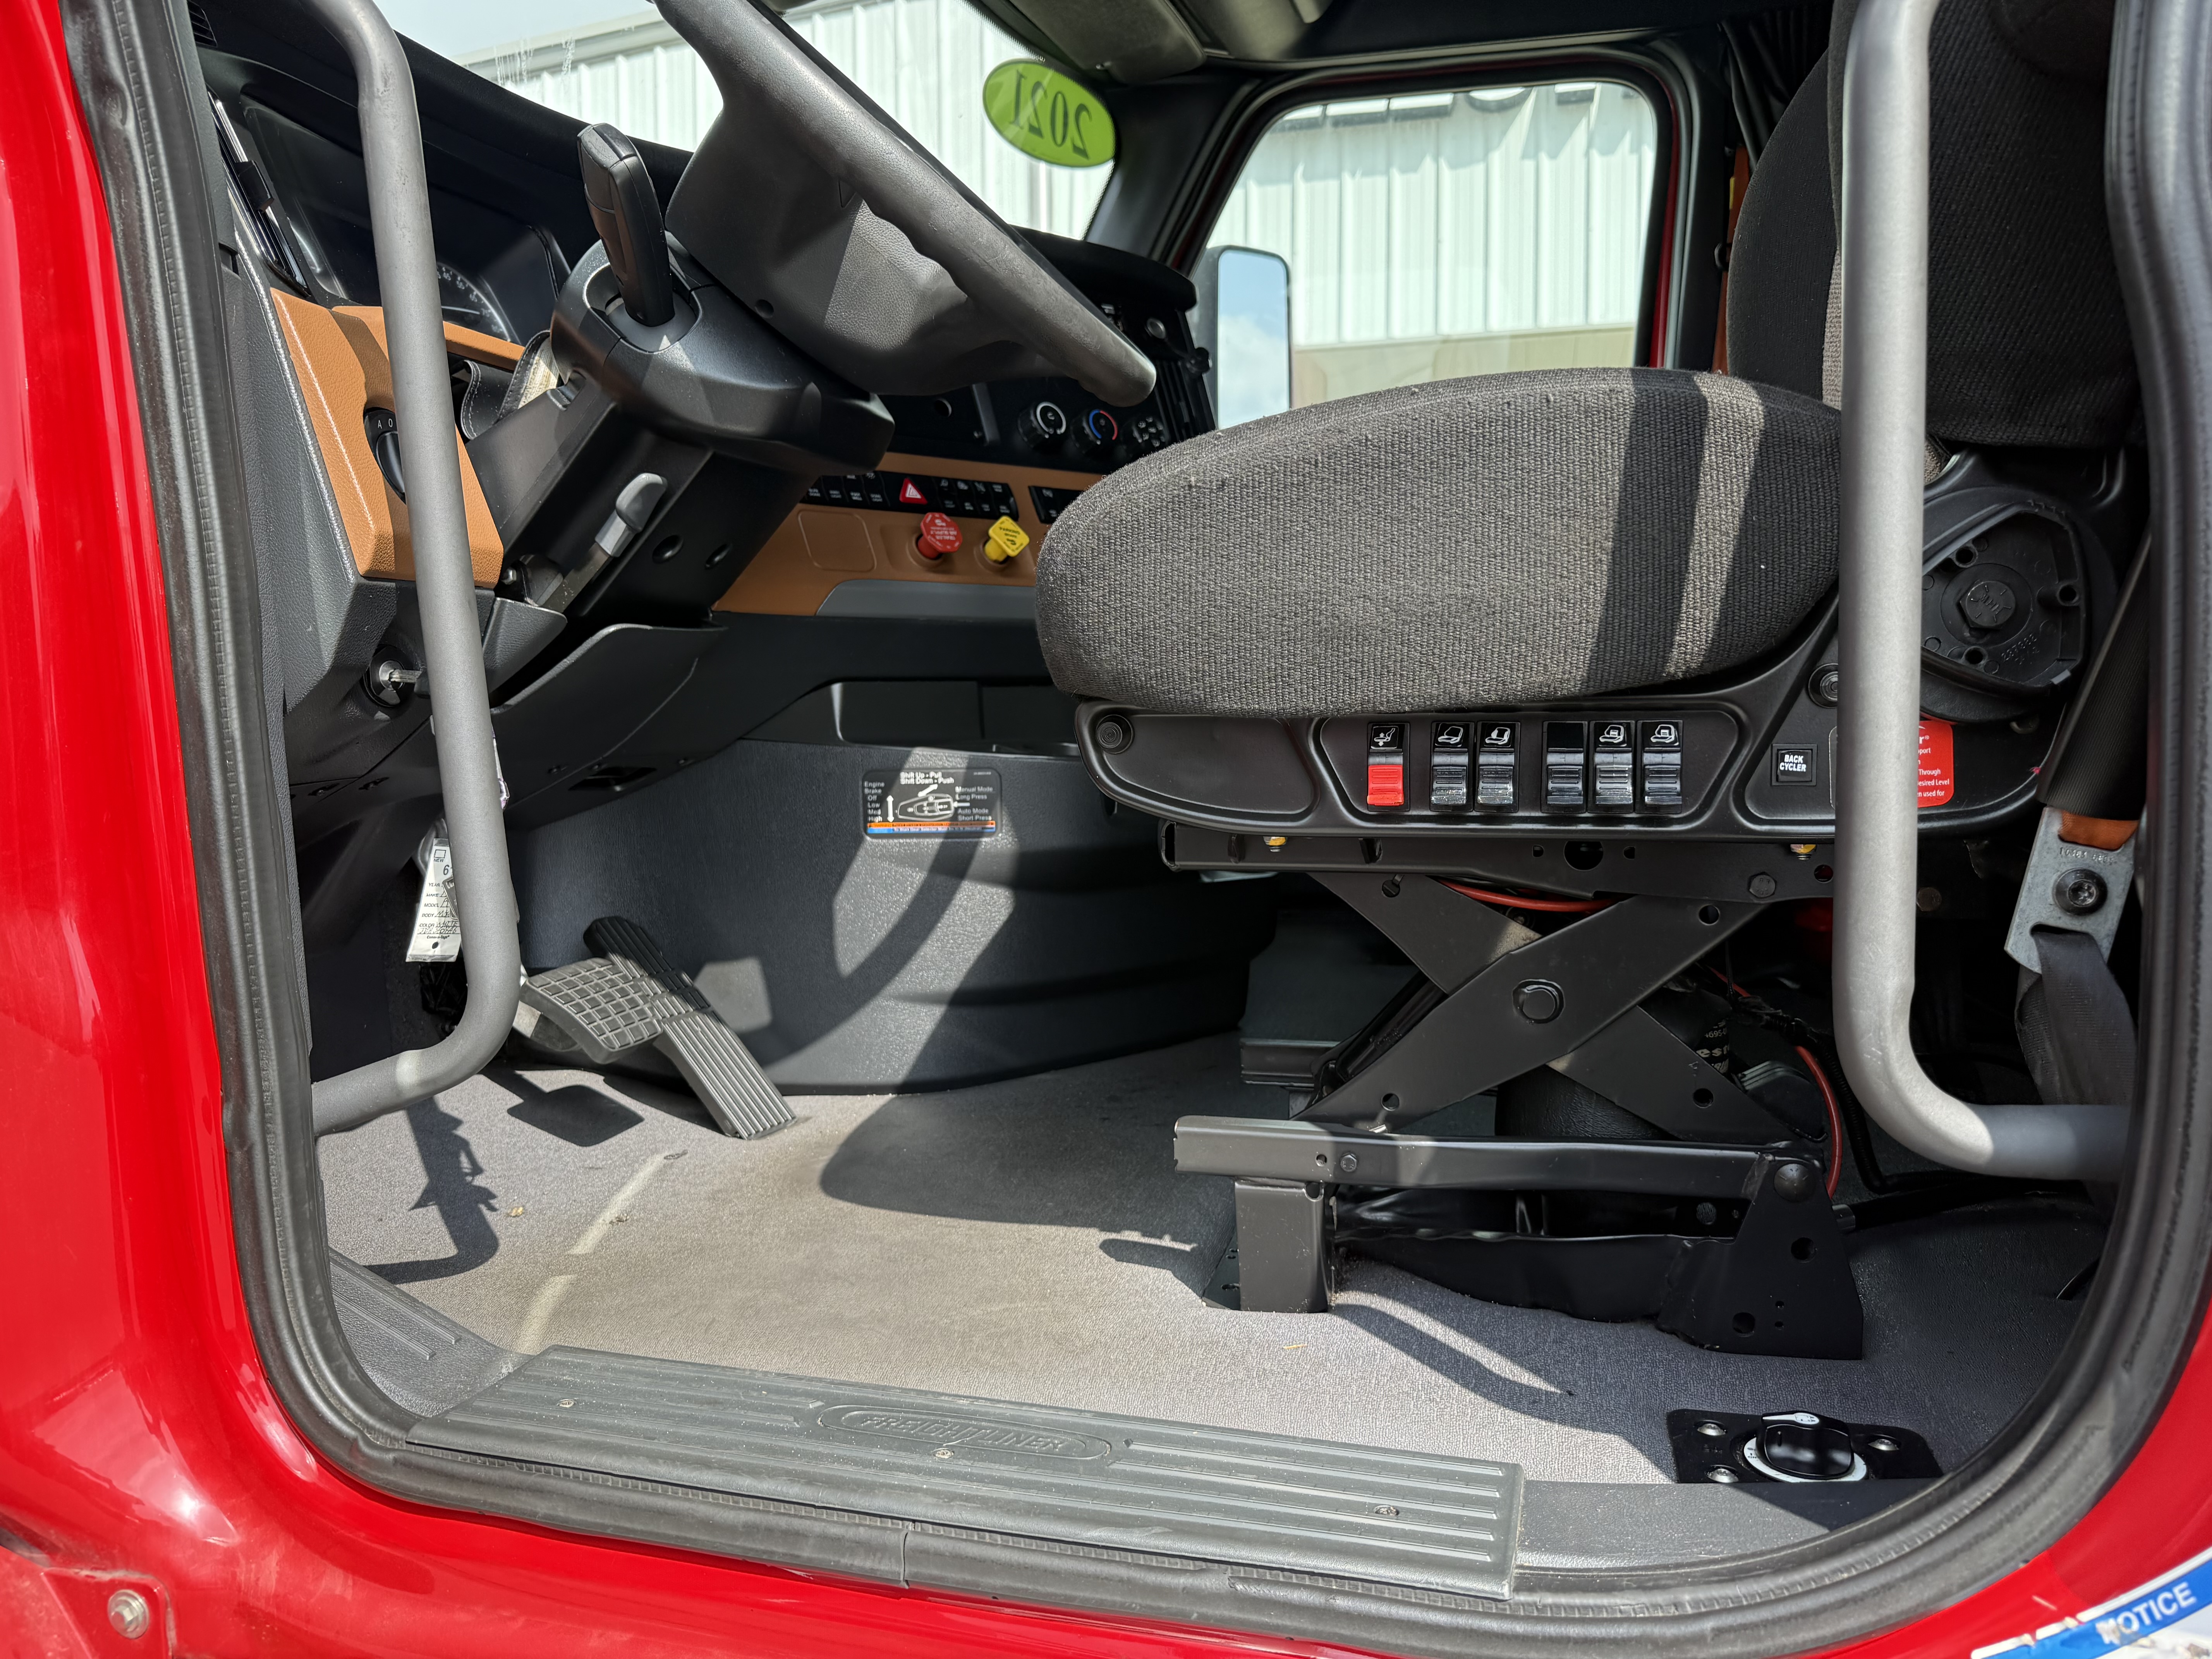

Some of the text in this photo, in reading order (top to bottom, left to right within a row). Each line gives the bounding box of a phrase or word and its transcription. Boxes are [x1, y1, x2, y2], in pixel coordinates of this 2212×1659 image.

[378, 420, 382, 429] A
[1784, 754, 1803, 763] BACK
[1779, 762, 1806, 772] CYCLER
[860, 1417, 1066, 1451] FREIGHTLINER
[2095, 1581, 2197, 1644] NOTICE
